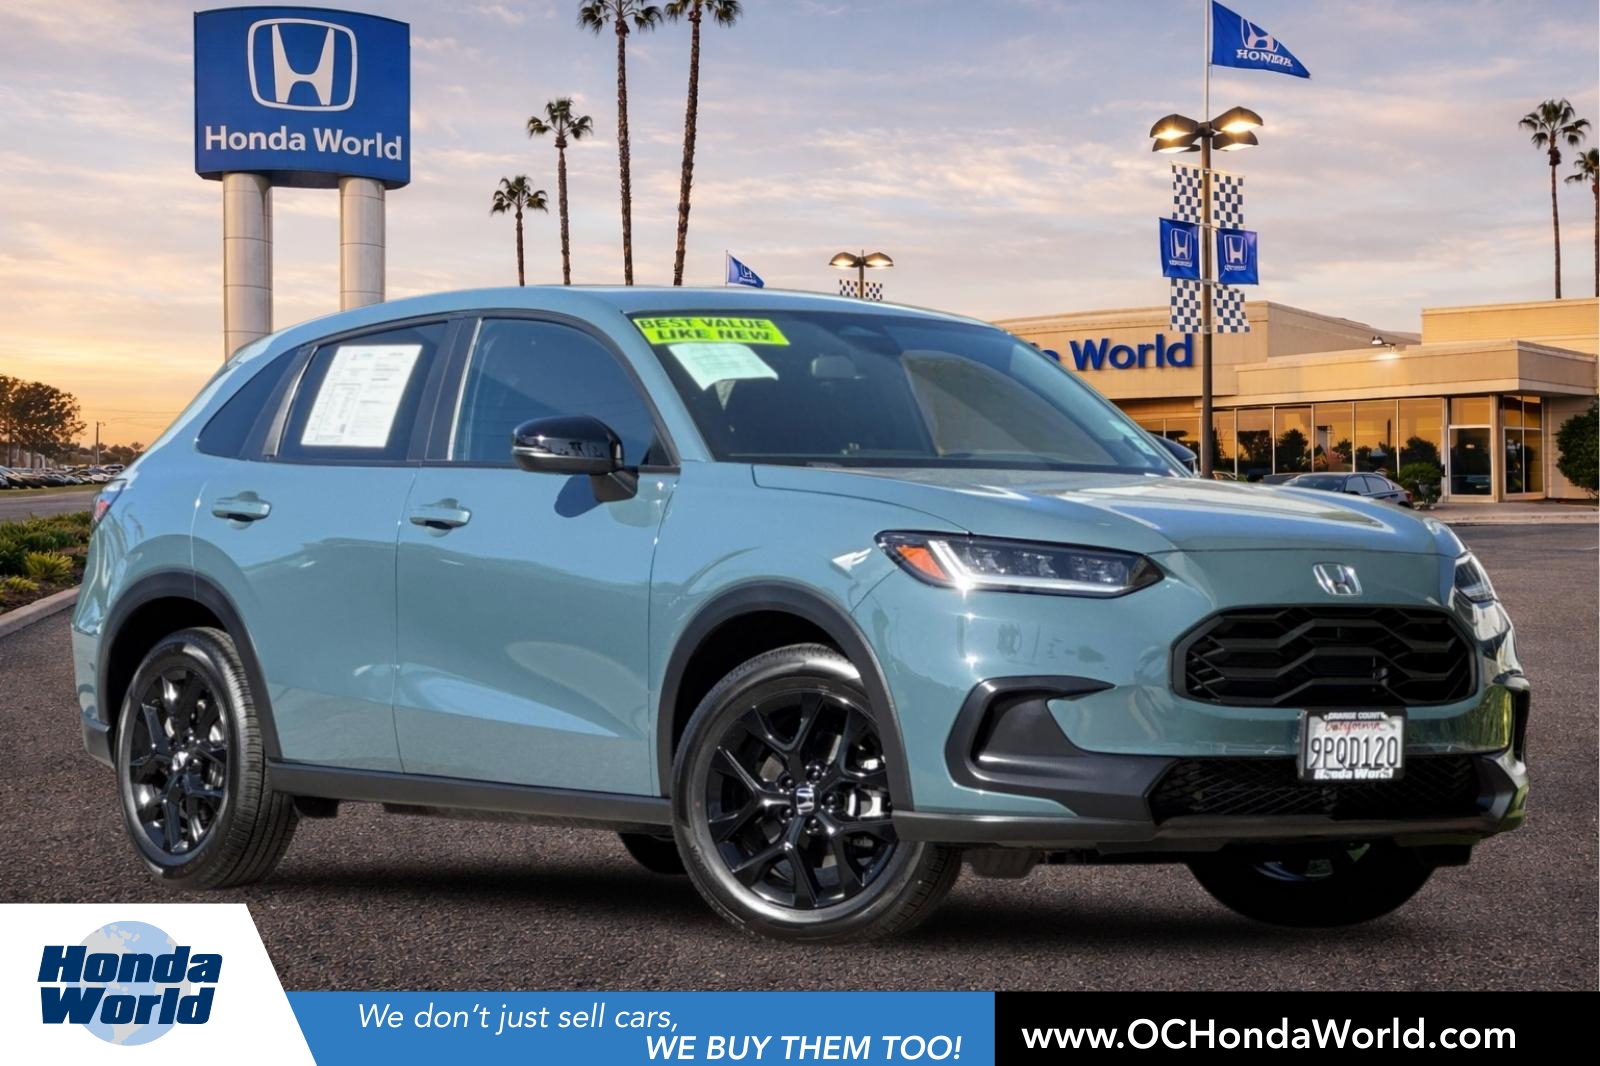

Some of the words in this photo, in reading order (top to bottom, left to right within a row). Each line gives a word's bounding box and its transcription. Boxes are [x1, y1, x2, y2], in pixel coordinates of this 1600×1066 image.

[205, 125, 306, 151] Honda
[313, 128, 402, 161] World
[640, 319, 695, 328] BEST
[701, 319, 769, 329] VALUE
[657, 329, 710, 340] LIKE
[717, 330, 769, 341] NEW
[1069, 333, 1194, 371] World
[1325, 720, 1386, 736] California
[1310, 736, 1398, 769] 9PQD120
[1313, 768, 1353, 779] Honda
[1354, 768, 1394, 779] World
